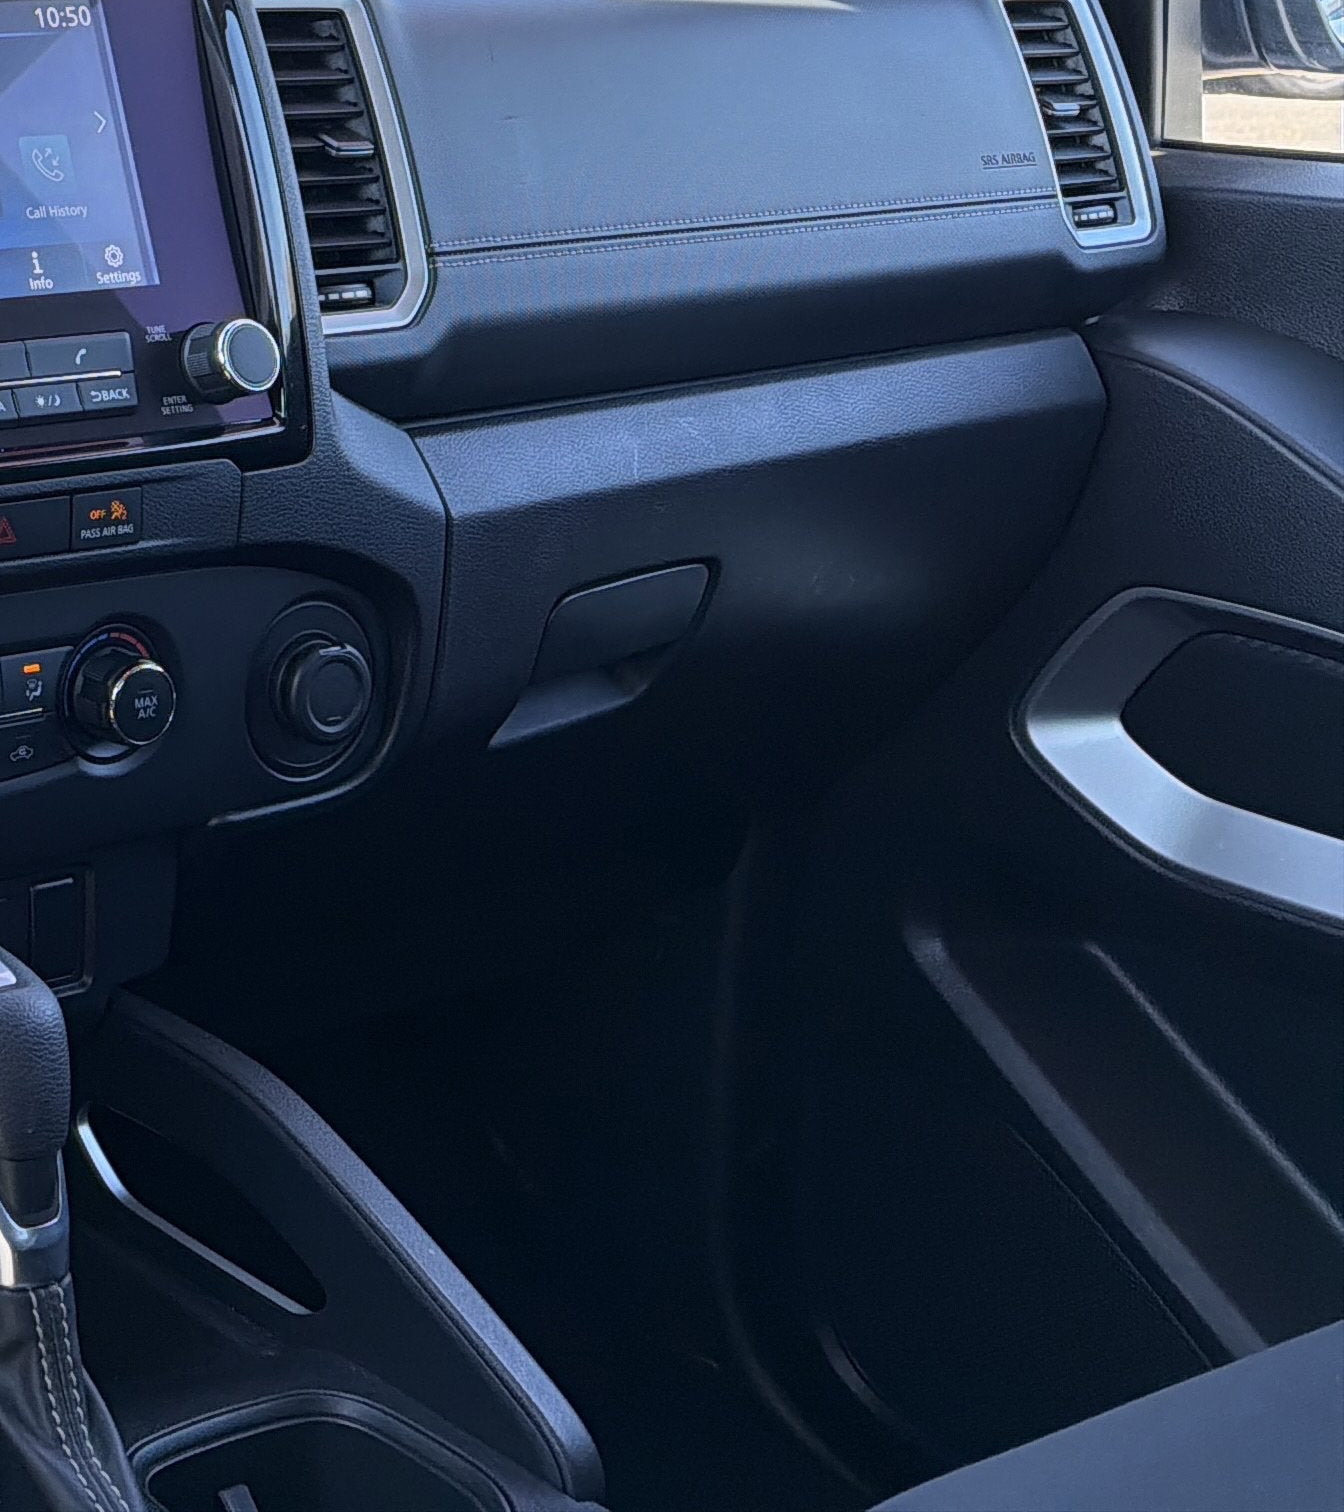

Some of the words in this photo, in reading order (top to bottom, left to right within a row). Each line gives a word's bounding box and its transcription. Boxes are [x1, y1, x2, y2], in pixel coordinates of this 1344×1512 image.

[34, 5, 91, 29] 10:50
[981, 153, 999, 166] SRS
[1001, 151, 1036, 165] AIRBAG
[26, 204, 48, 219] Call
[49, 203, 88, 219] History
[96, 268, 142, 285] Settings
[29, 276, 54, 291] Info
[146, 325, 166, 334] TUNE
[145, 333, 172, 343] SCROLL
[102, 388, 130, 401] BACK
[163, 395, 187, 405] ENTER
[161, 404, 194, 415] SETTING
[89, 509, 107, 521] OFF
[80, 527, 101, 539] PASS
[101, 526, 117, 537] AIR
[117, 524, 134, 535] BAG
[134, 695, 159, 708] MAX
[137, 706, 156, 719] A/C
